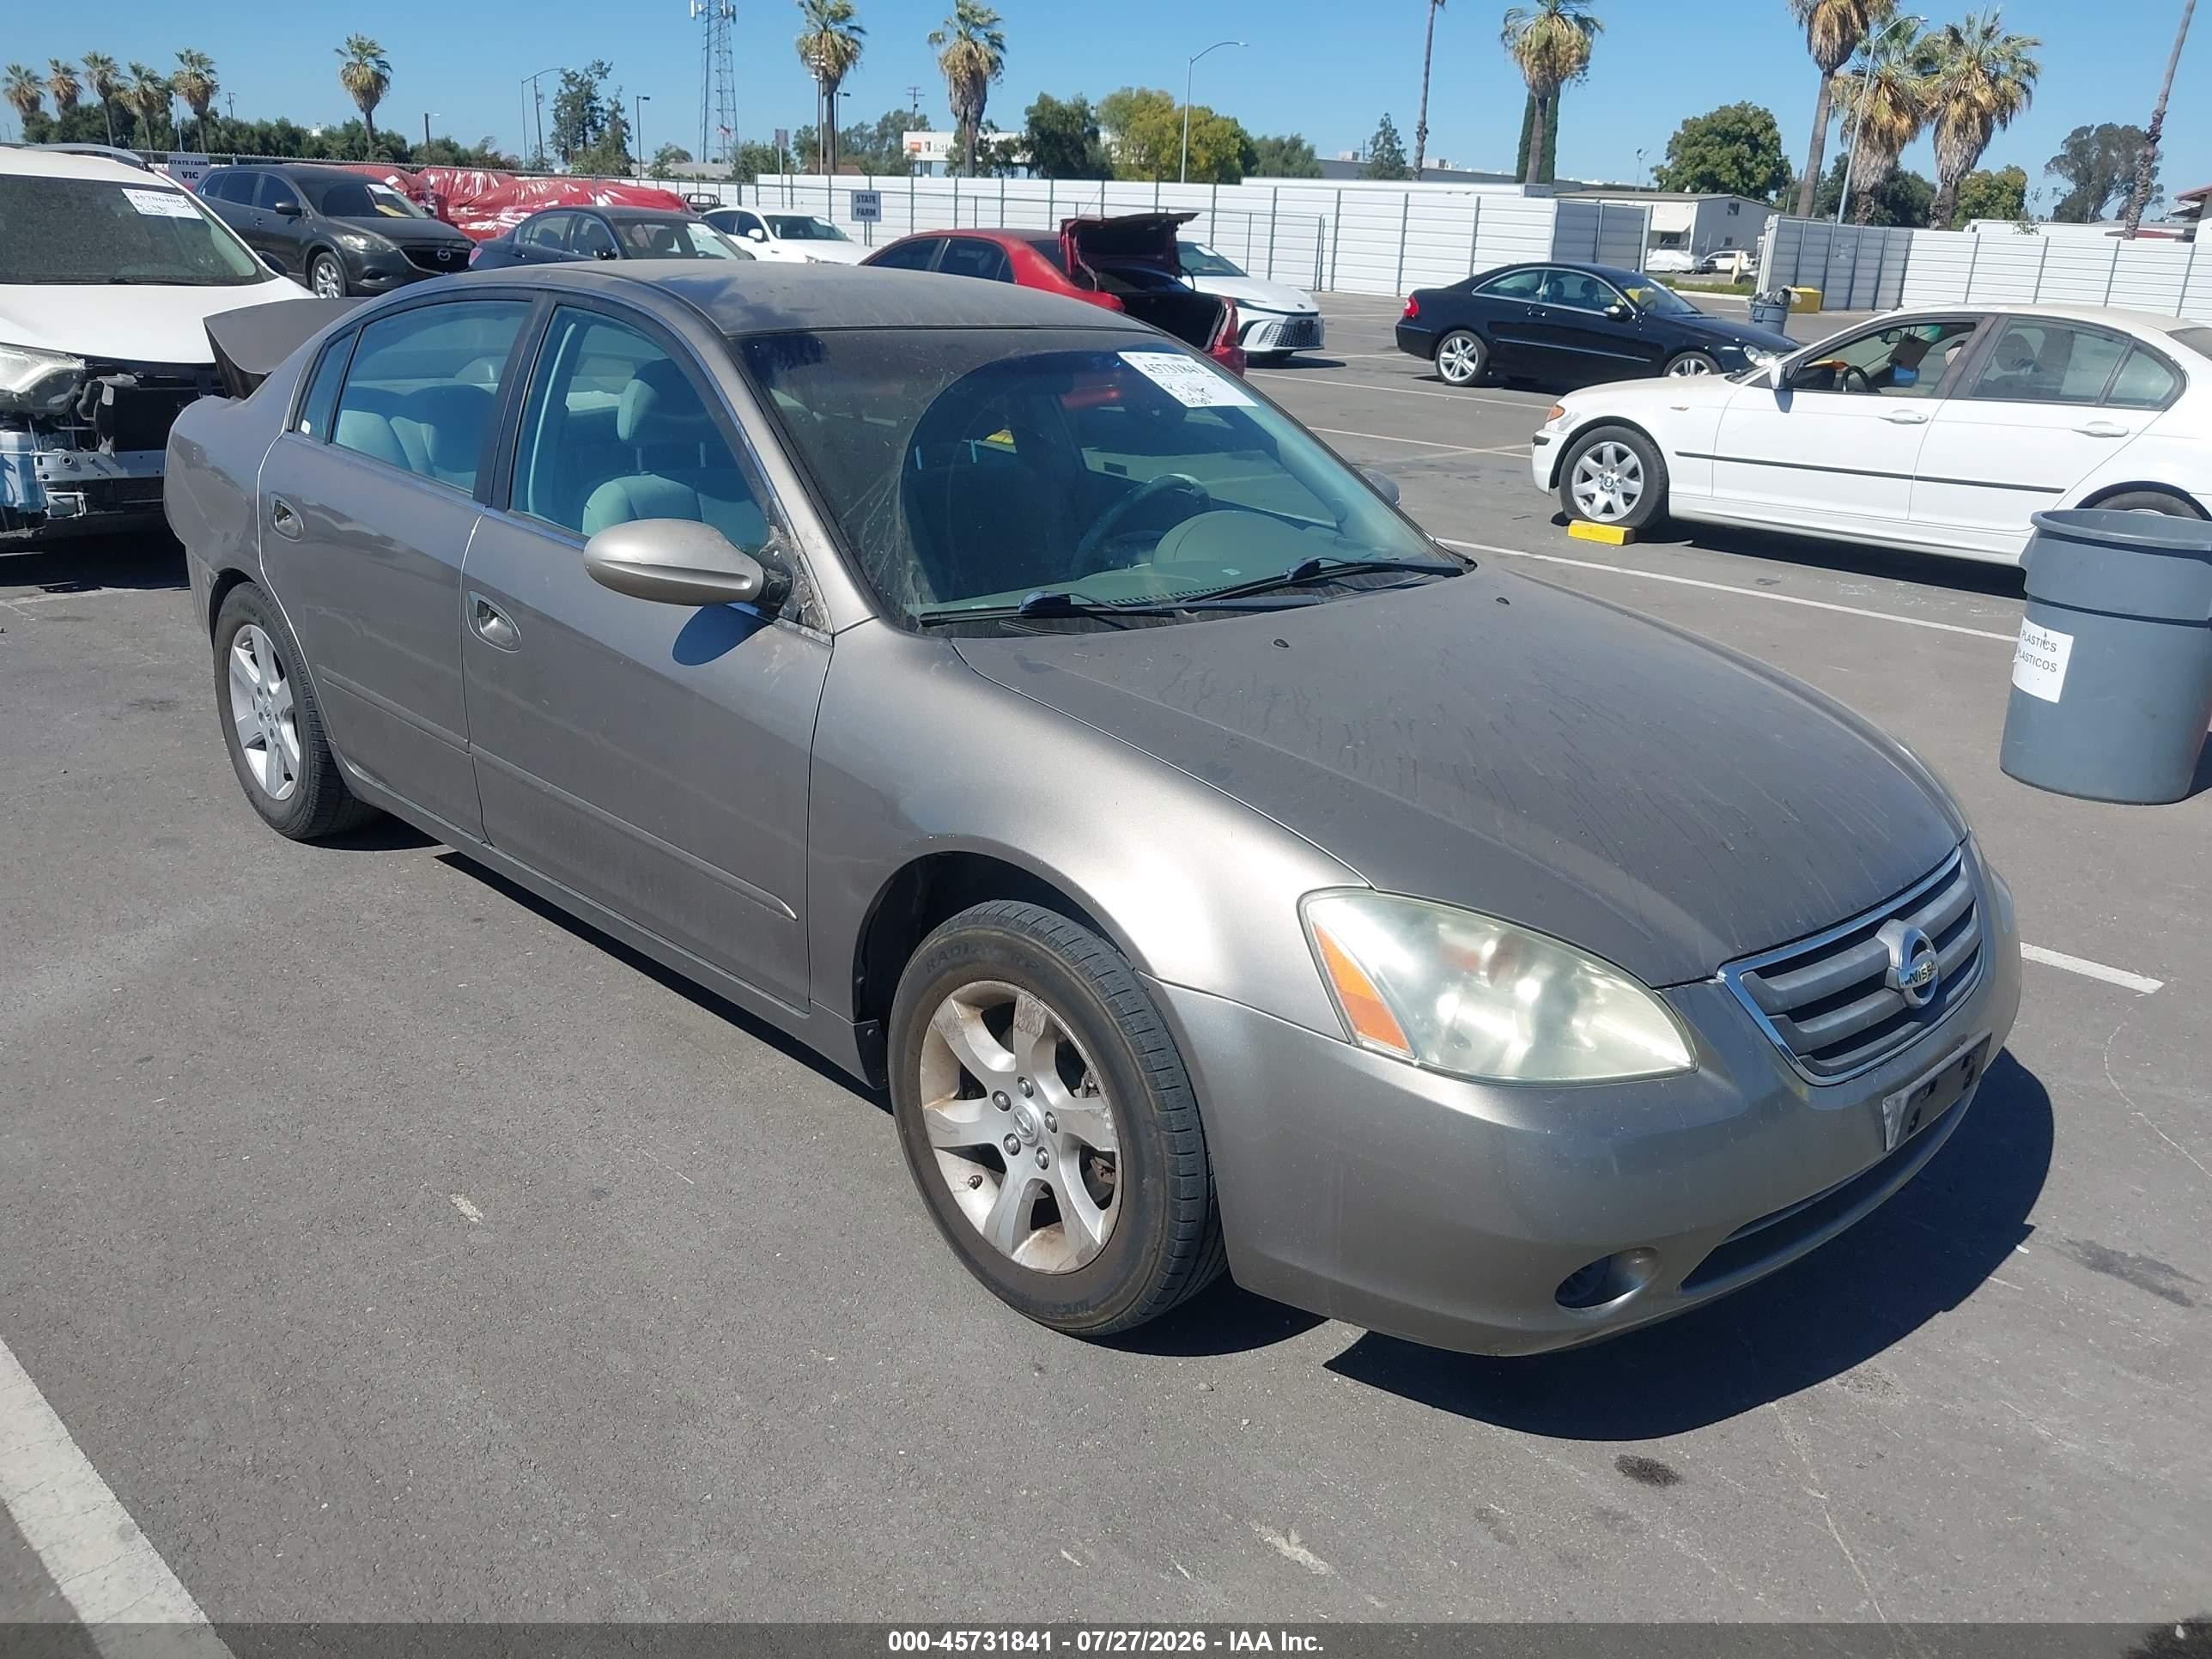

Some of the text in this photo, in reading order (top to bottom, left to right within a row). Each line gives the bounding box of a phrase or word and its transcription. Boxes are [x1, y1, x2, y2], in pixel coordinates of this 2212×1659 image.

[181, 171, 199, 179] VIC
[856, 194, 876, 204] STATE
[856, 208, 876, 216] FARM
[2022, 629, 2057, 653] PLASTICS
[1909, 960, 1937, 984] NISSA
